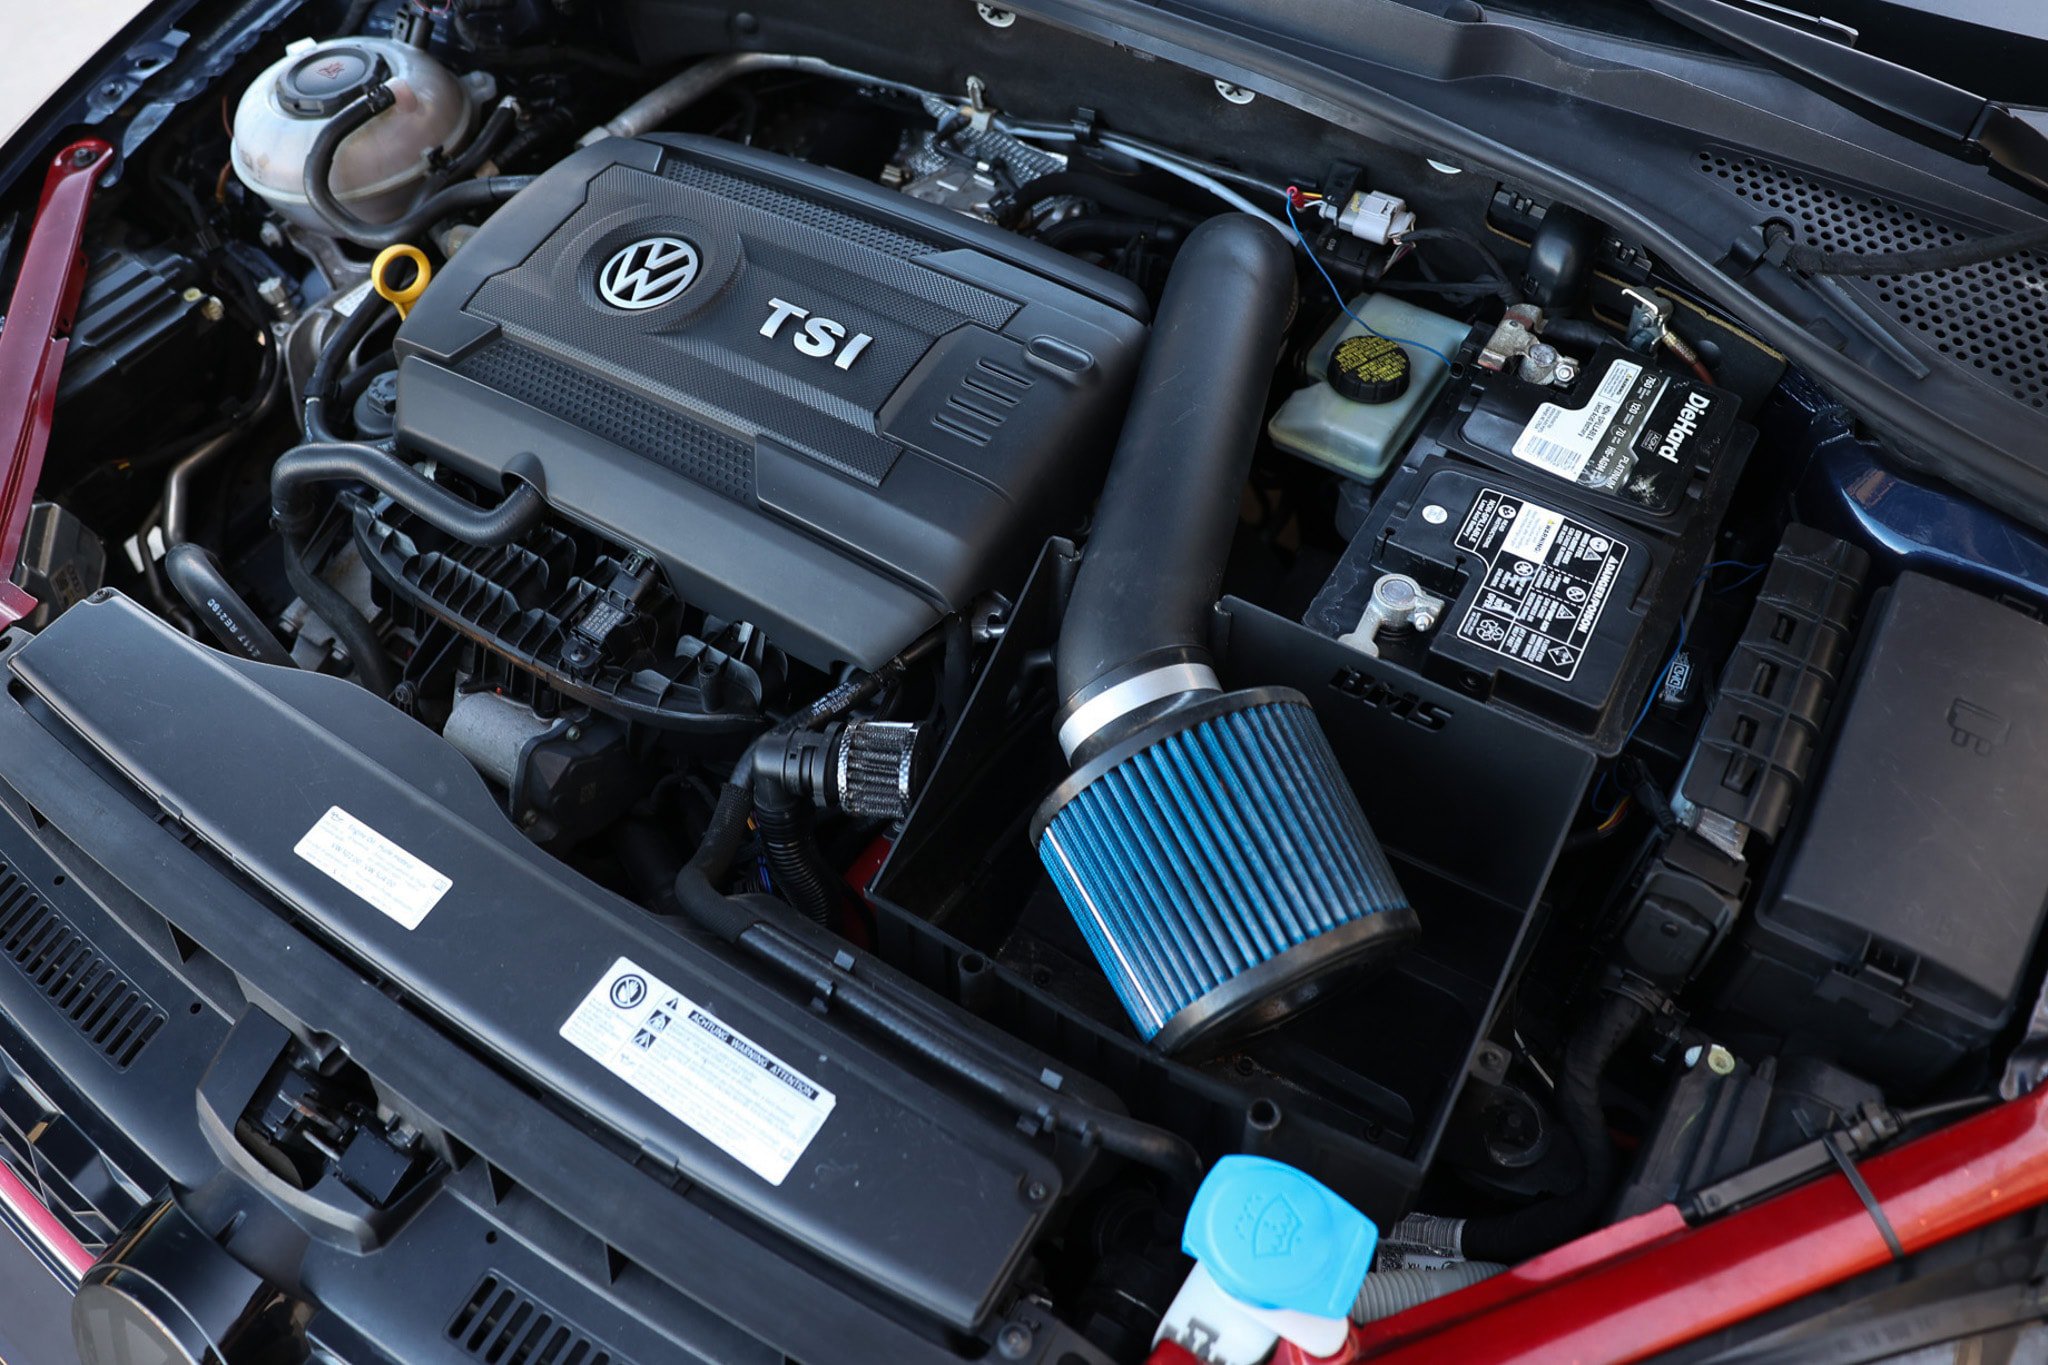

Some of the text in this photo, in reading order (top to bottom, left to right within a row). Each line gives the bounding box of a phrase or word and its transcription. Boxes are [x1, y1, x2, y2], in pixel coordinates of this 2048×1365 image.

[758, 297, 874, 371] TSI
[1614, 427, 1627, 437] 70
[1627, 402, 1641, 414] 120
[1655, 391, 1712, 463] DieHard
[1605, 455, 1629, 489] PLATINUM
[1577, 562, 1615, 633] DANGER/POISON
[1328, 667, 1454, 733] BMS
[691, 1011, 815, 1099] ACHTUNG WARNING ATTENTION
